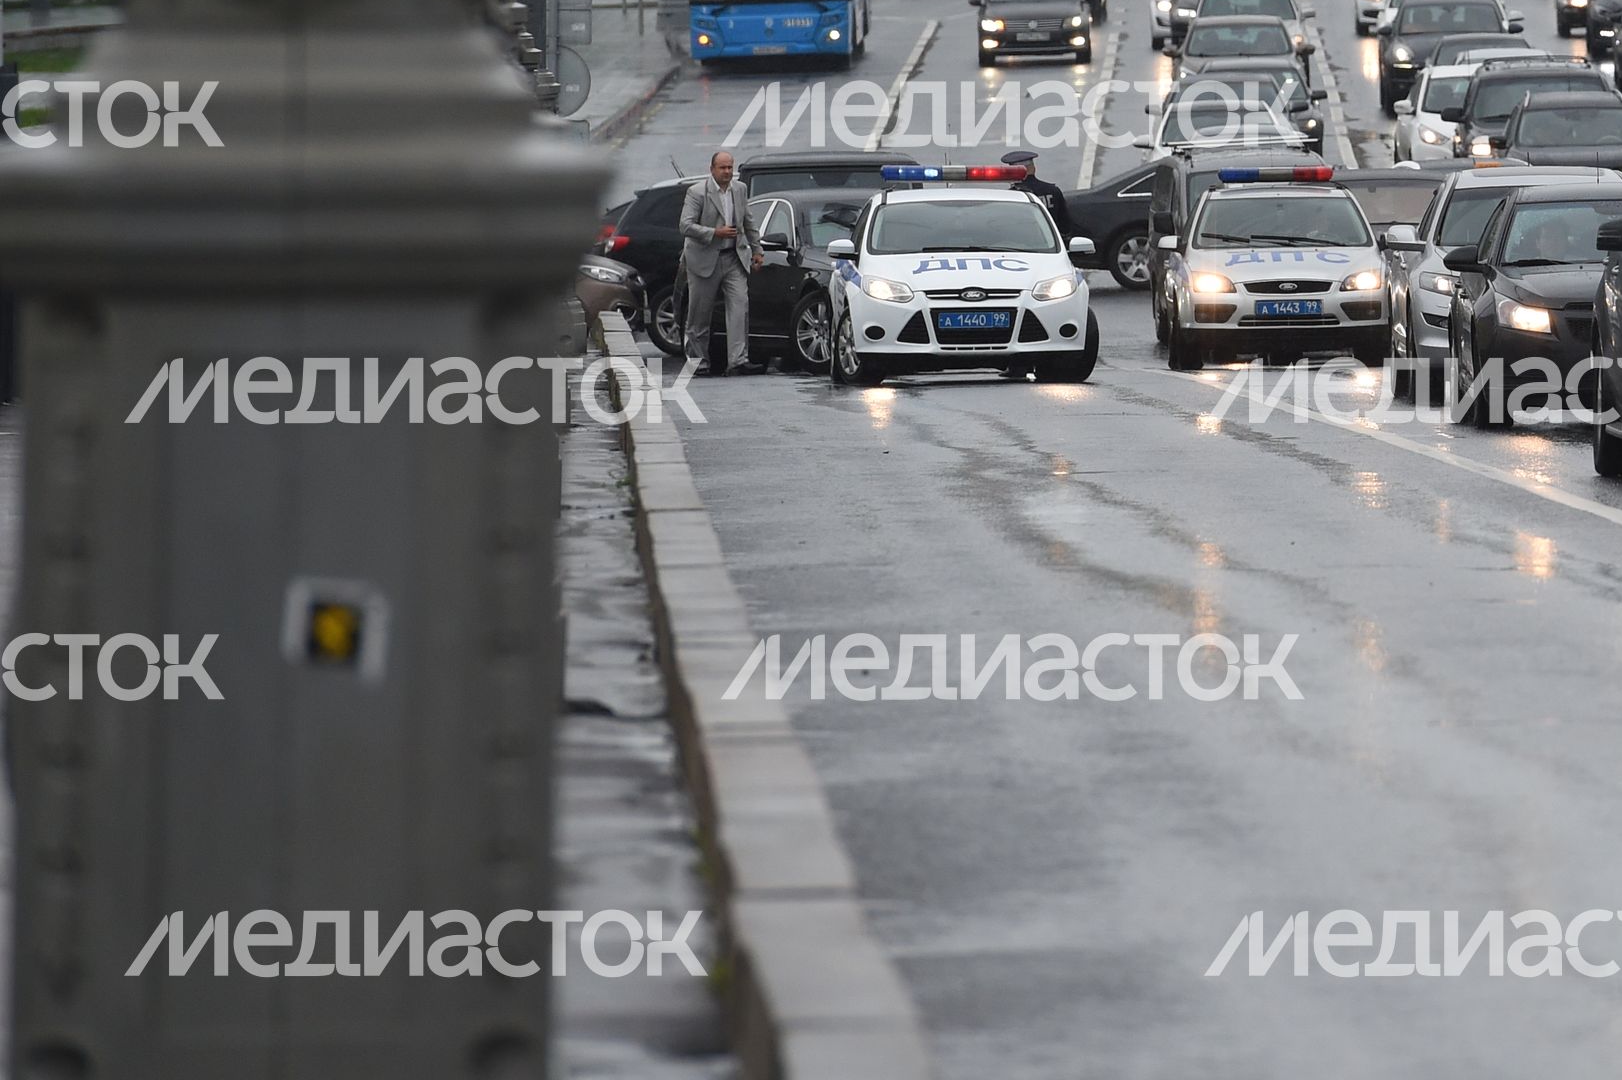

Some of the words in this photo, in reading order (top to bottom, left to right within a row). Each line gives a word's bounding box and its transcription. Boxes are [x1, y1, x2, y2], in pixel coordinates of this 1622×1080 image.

[912, 257, 1030, 275] ДПС
[1225, 250, 1351, 267] ДПС
[1273, 303, 1300, 313] 1443
[1306, 301, 1317, 309] 99
[957, 314, 987, 326] 1440
[993, 313, 1005, 322] 99
